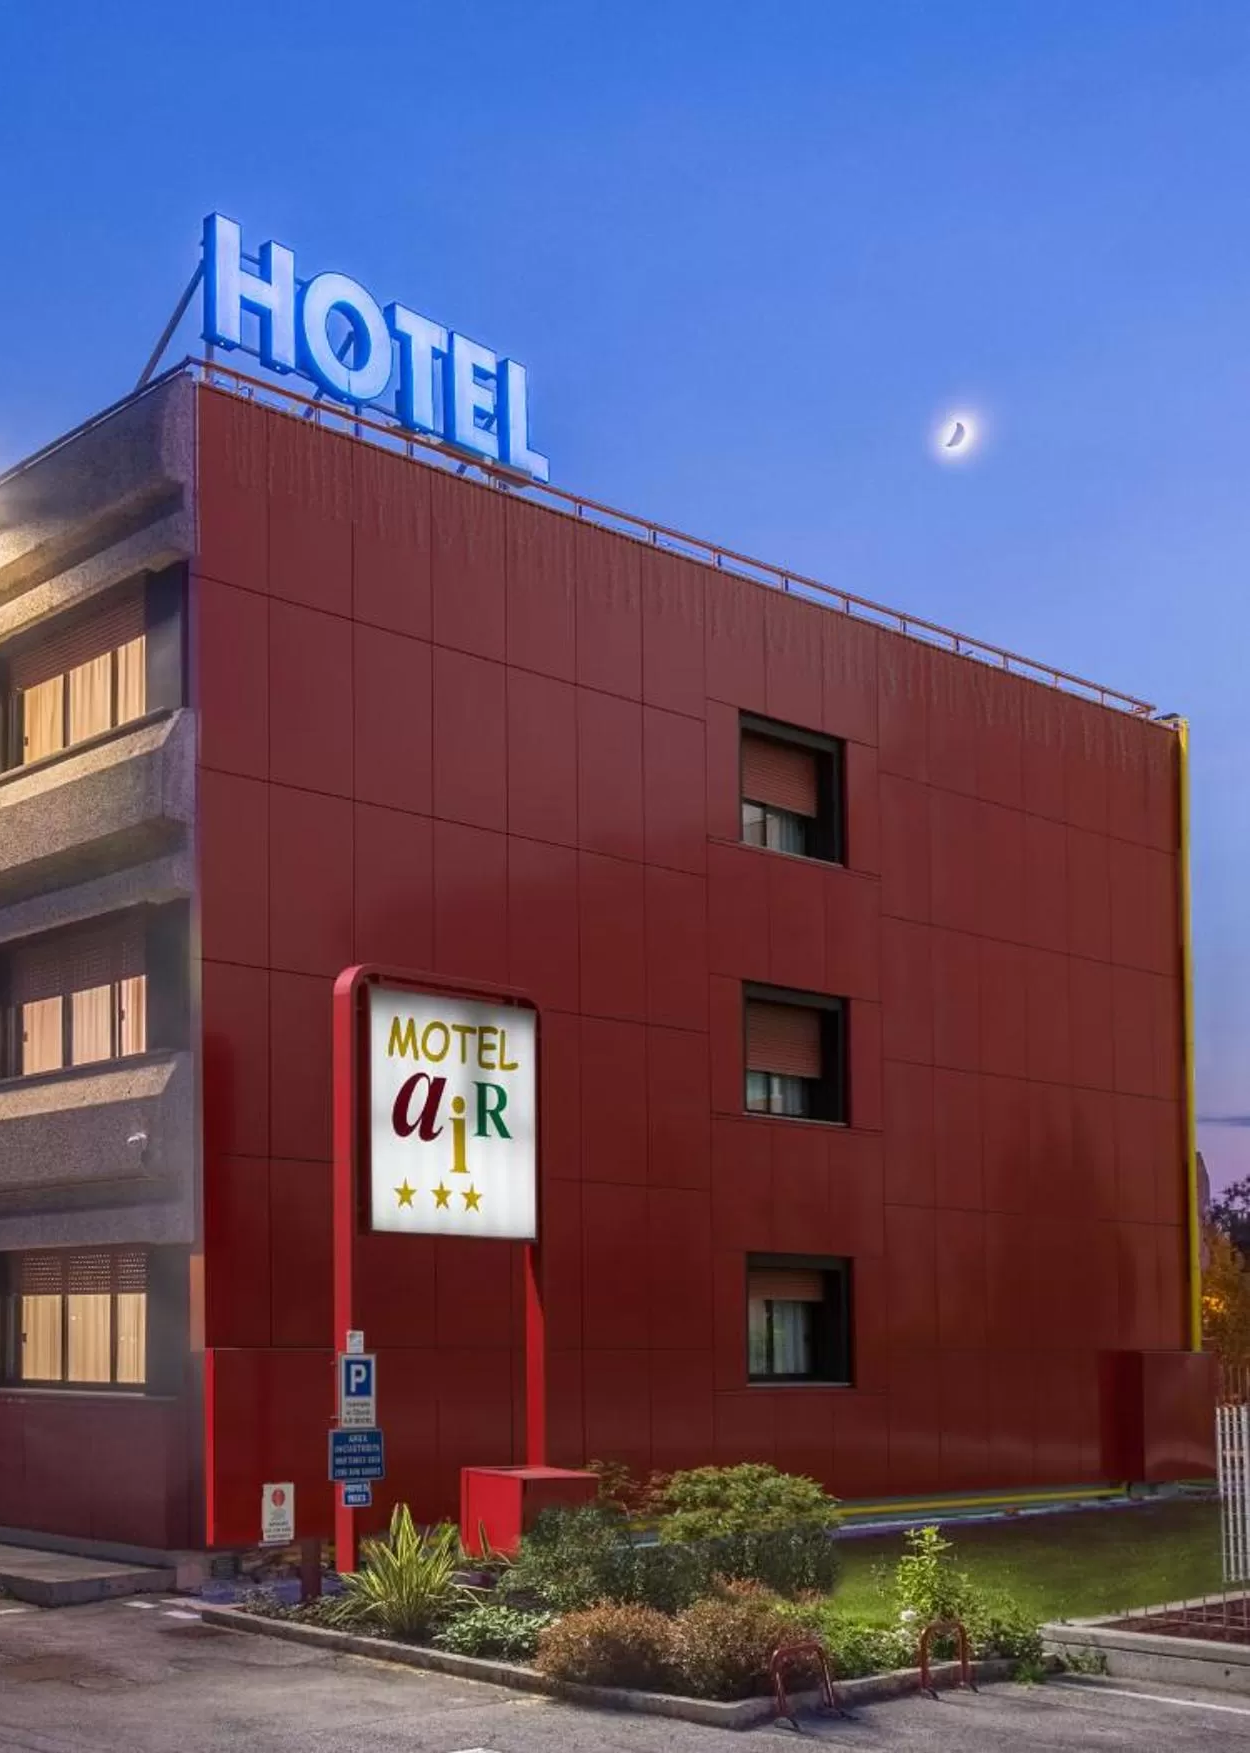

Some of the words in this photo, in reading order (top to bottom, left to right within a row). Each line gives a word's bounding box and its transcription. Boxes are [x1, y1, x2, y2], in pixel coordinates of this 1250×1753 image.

[204, 212, 550, 484] HOTEL
[388, 1016, 519, 1071] MOTEL
[350, 1364, 367, 1393] P
